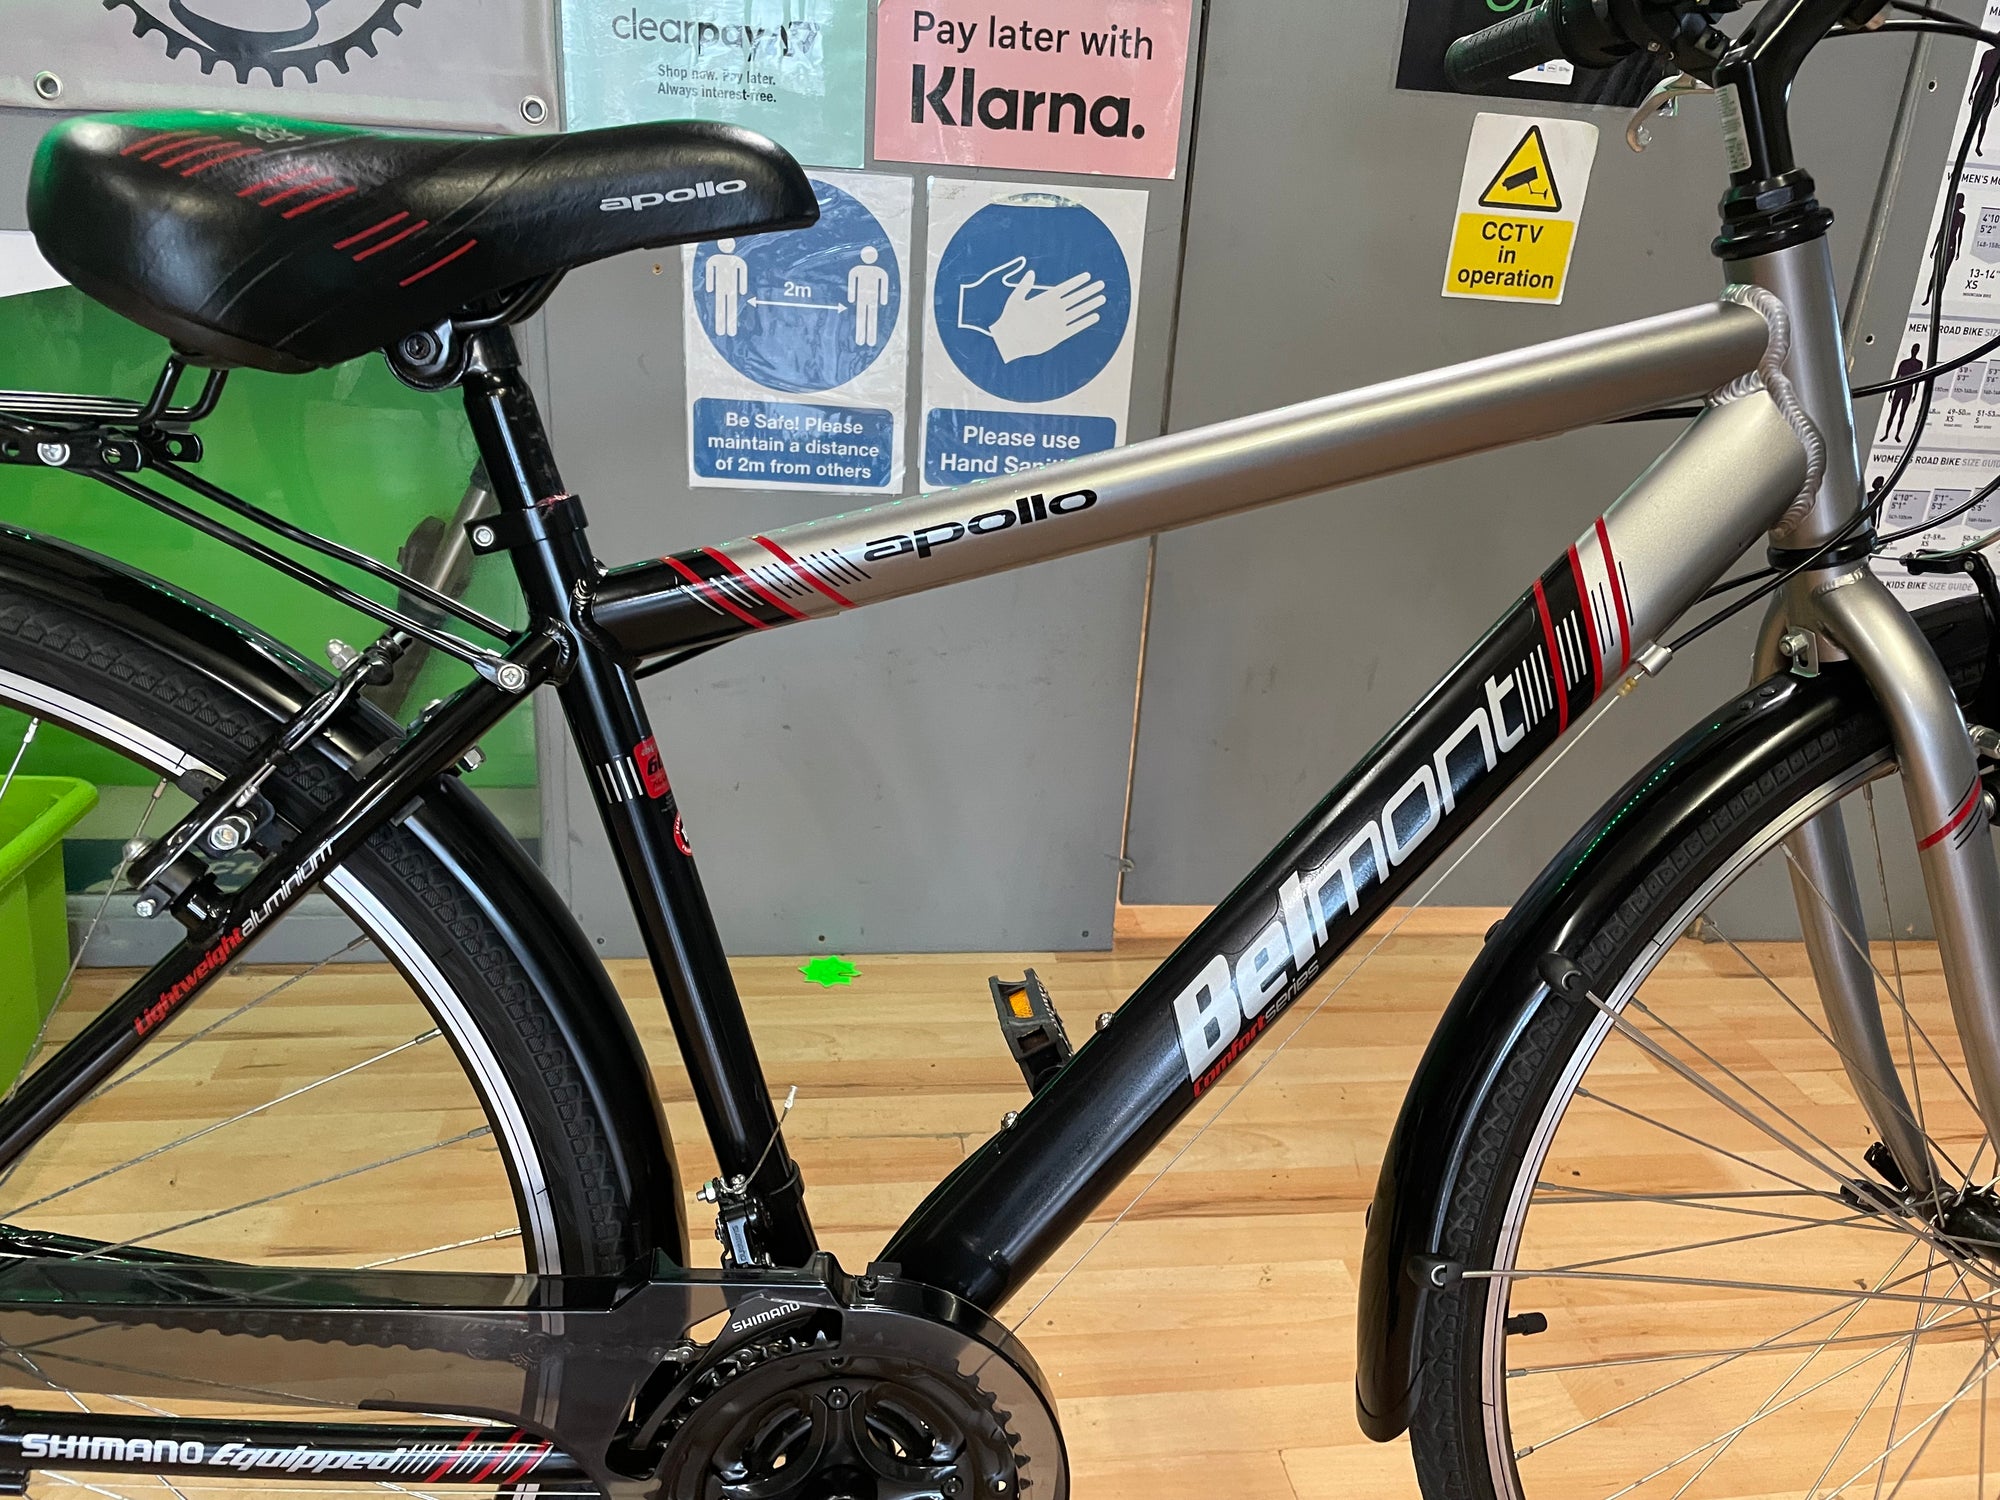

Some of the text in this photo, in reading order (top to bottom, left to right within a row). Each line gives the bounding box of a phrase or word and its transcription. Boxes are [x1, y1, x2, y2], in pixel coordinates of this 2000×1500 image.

[913, 10, 1153, 60] Pay later with
[657, 64, 688, 80] Shop
[746, 70, 776, 86] later.
[657, 82, 699, 97] Always
[911, 64, 1146, 140] Klarna.
[599, 179, 748, 212] apollo
[1481, 221, 1544, 243] CCTV
[1498, 245, 1516, 264] in
[783, 281, 812, 298] 2m
[1458, 268, 1555, 289] operation
[1965, 280, 1979, 290] XS
[1963, 326, 1984, 336] BIKE
[725, 412, 863, 434] Be Safe! Please
[708, 435, 880, 458] maintain a distance
[962, 425, 1081, 449] Please use
[715, 456, 872, 479] of 2m from others
[940, 453, 998, 473] Hand
[1915, 456, 1938, 465] ROAD
[1940, 457, 1961, 467] BIKE
[1962, 458, 1980, 467] SIZE
[863, 489, 1098, 562] apollo
[1886, 581, 1974, 591] KIDS BIKE SIZE GUIDE
[1172, 674, 1527, 1084] Belmont
[731, 1302, 801, 1333] SHIMANO
[20, 1432, 406, 1474] SHIMANO Equipped
